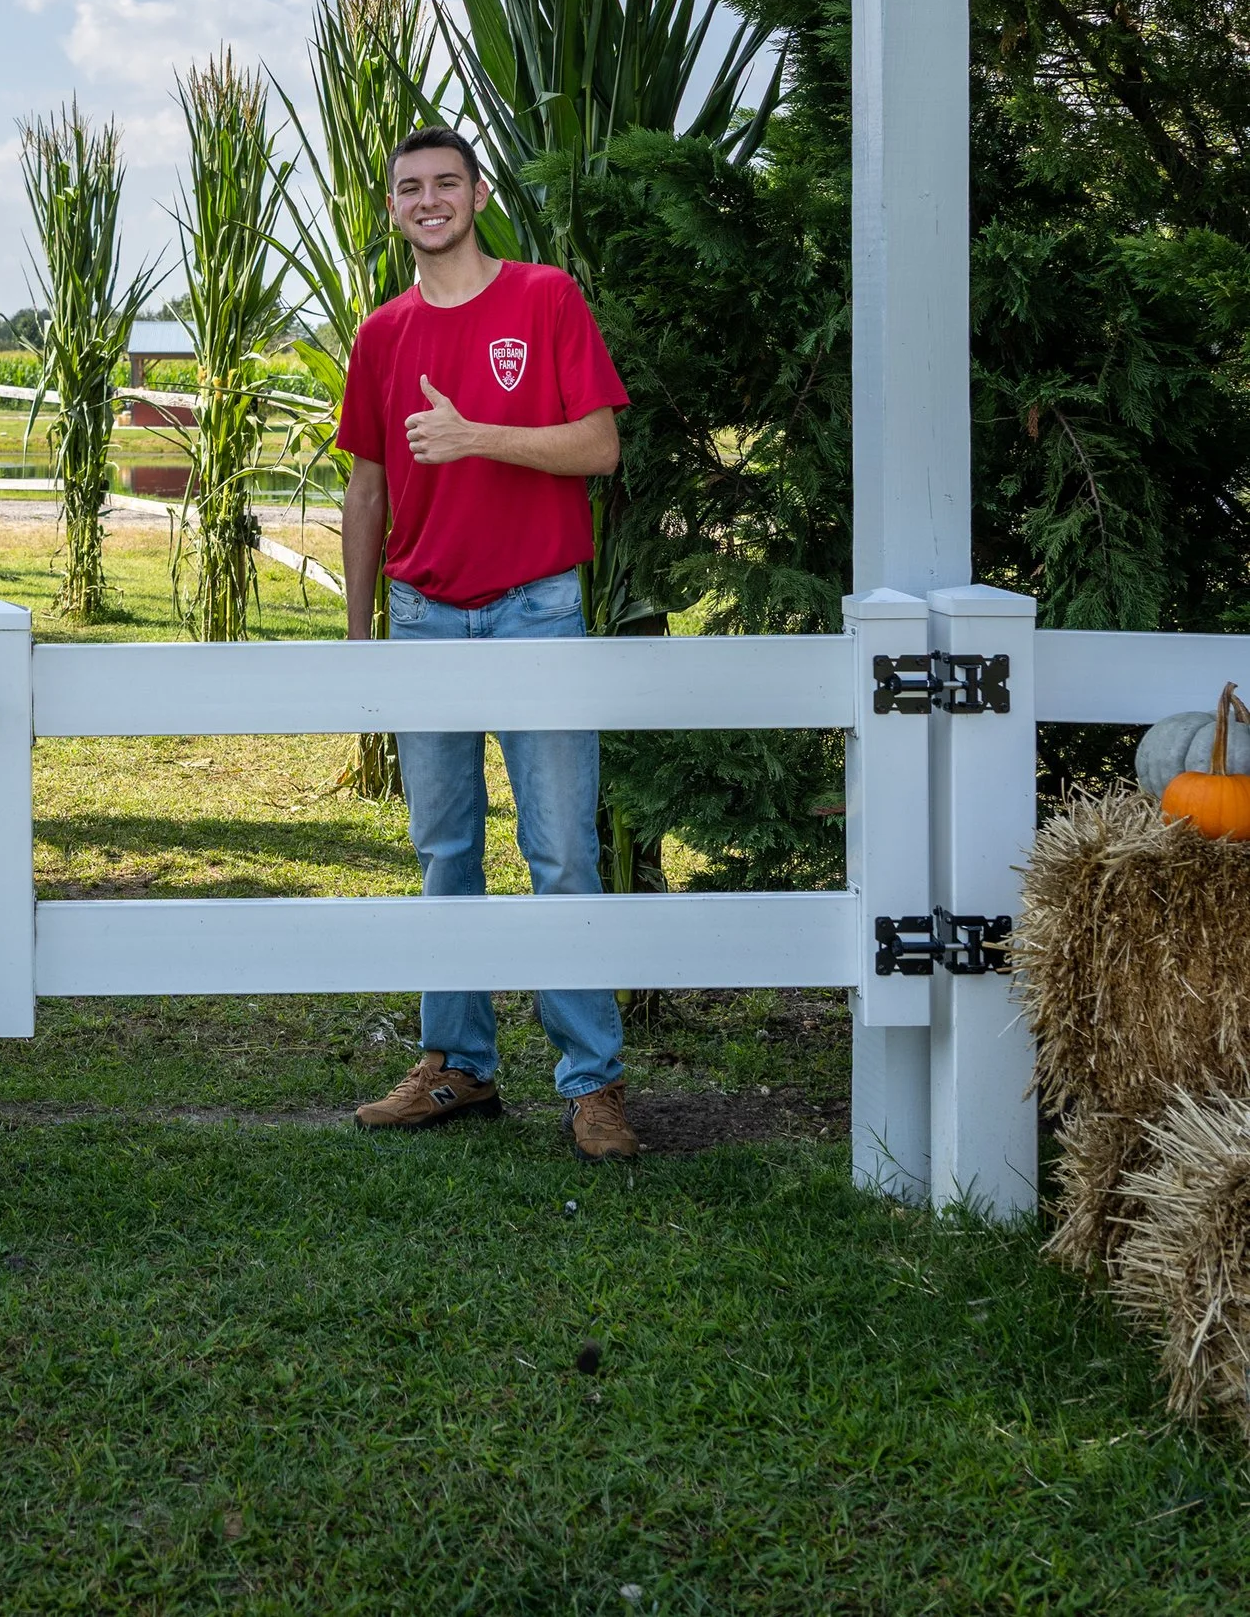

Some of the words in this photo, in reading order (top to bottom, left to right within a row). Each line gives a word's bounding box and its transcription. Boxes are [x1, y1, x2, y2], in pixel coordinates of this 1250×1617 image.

[493, 348, 506, 360] RED
[506, 348, 523, 360] BARN
[499, 360, 518, 372] FARM
